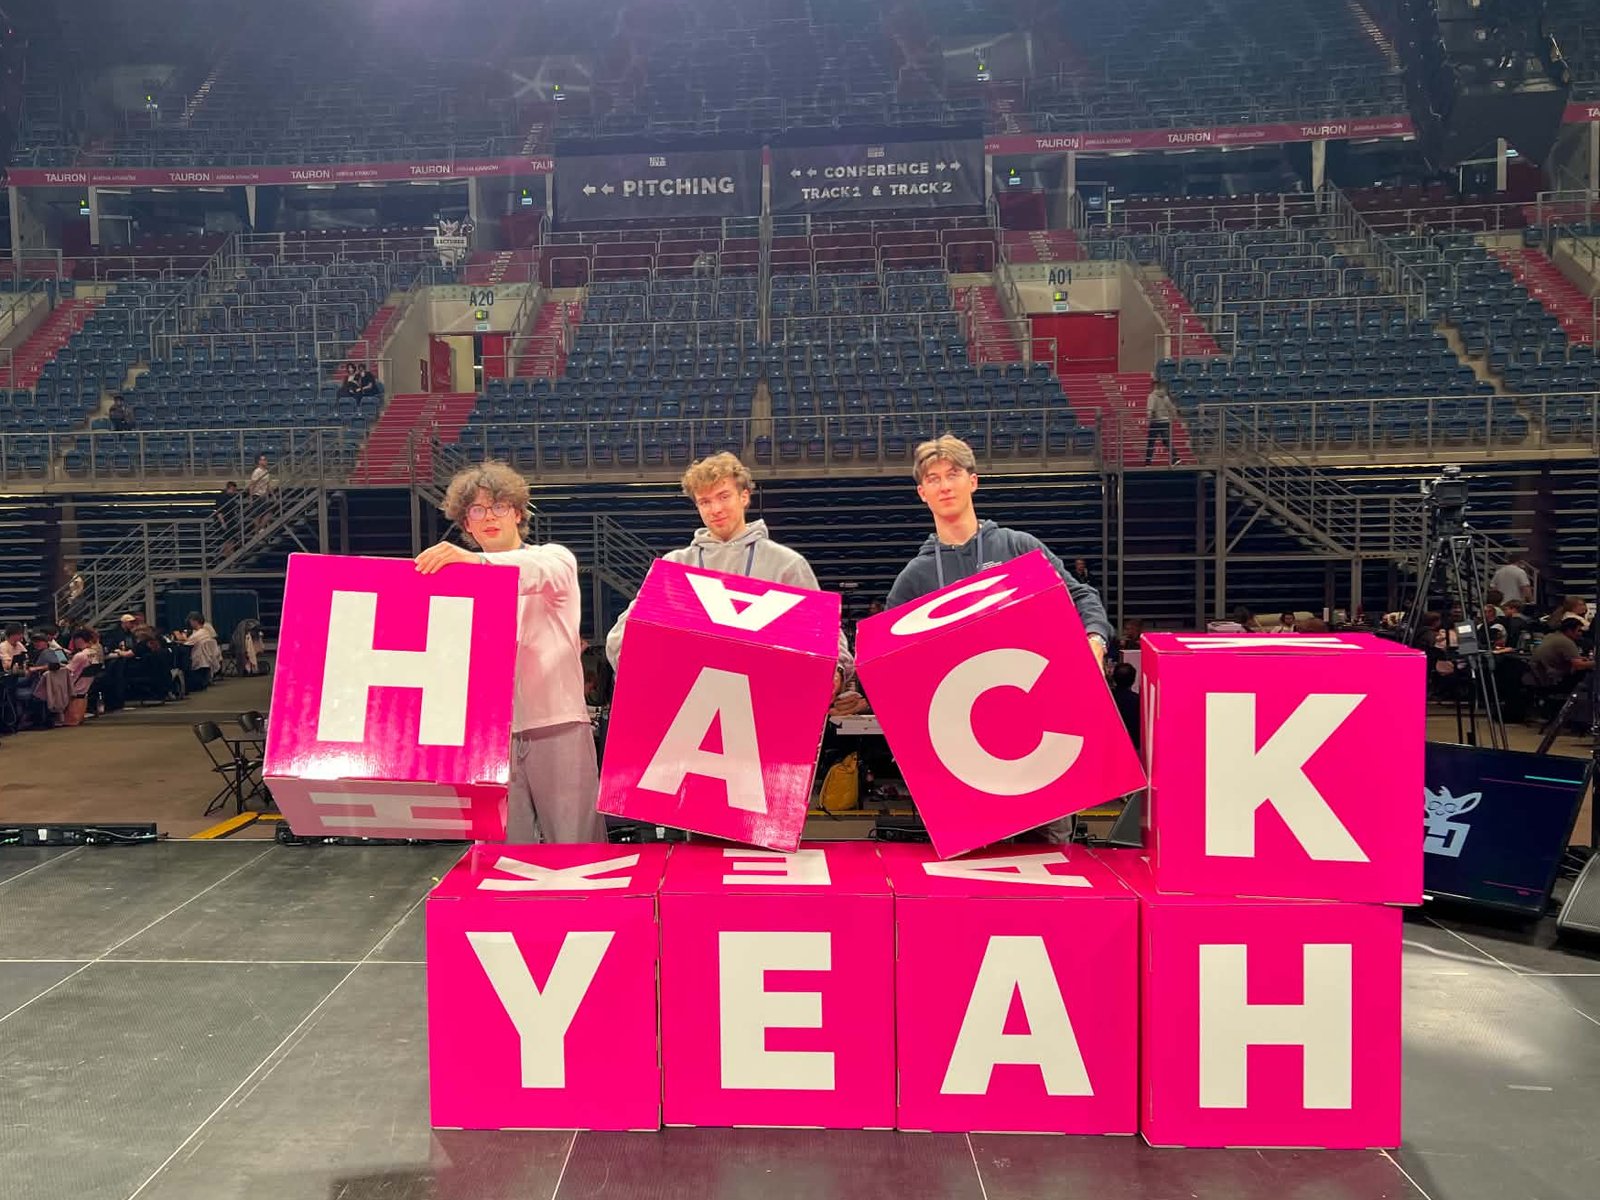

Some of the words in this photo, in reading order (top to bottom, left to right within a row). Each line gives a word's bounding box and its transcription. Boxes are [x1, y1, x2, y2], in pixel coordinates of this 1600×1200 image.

[1300, 123, 1346, 137] TAURON
[1036, 138, 1079, 149] TAURON
[1167, 131, 1211, 143] TAURON
[291, 169, 330, 179] TAURON
[410, 164, 450, 175] TAURON
[824, 162, 929, 178] CONFERENCE
[45, 173, 87, 183] TAURON
[170, 172, 210, 181] TAURON
[622, 176, 735, 197] PITCHING
[801, 186, 850, 200] TRACK
[872, 185, 882, 196] &
[890, 182, 939, 196] TRACK
[942, 181, 952, 193] 2
[1048, 268, 1072, 286] A01
[469, 290, 494, 307] A20
